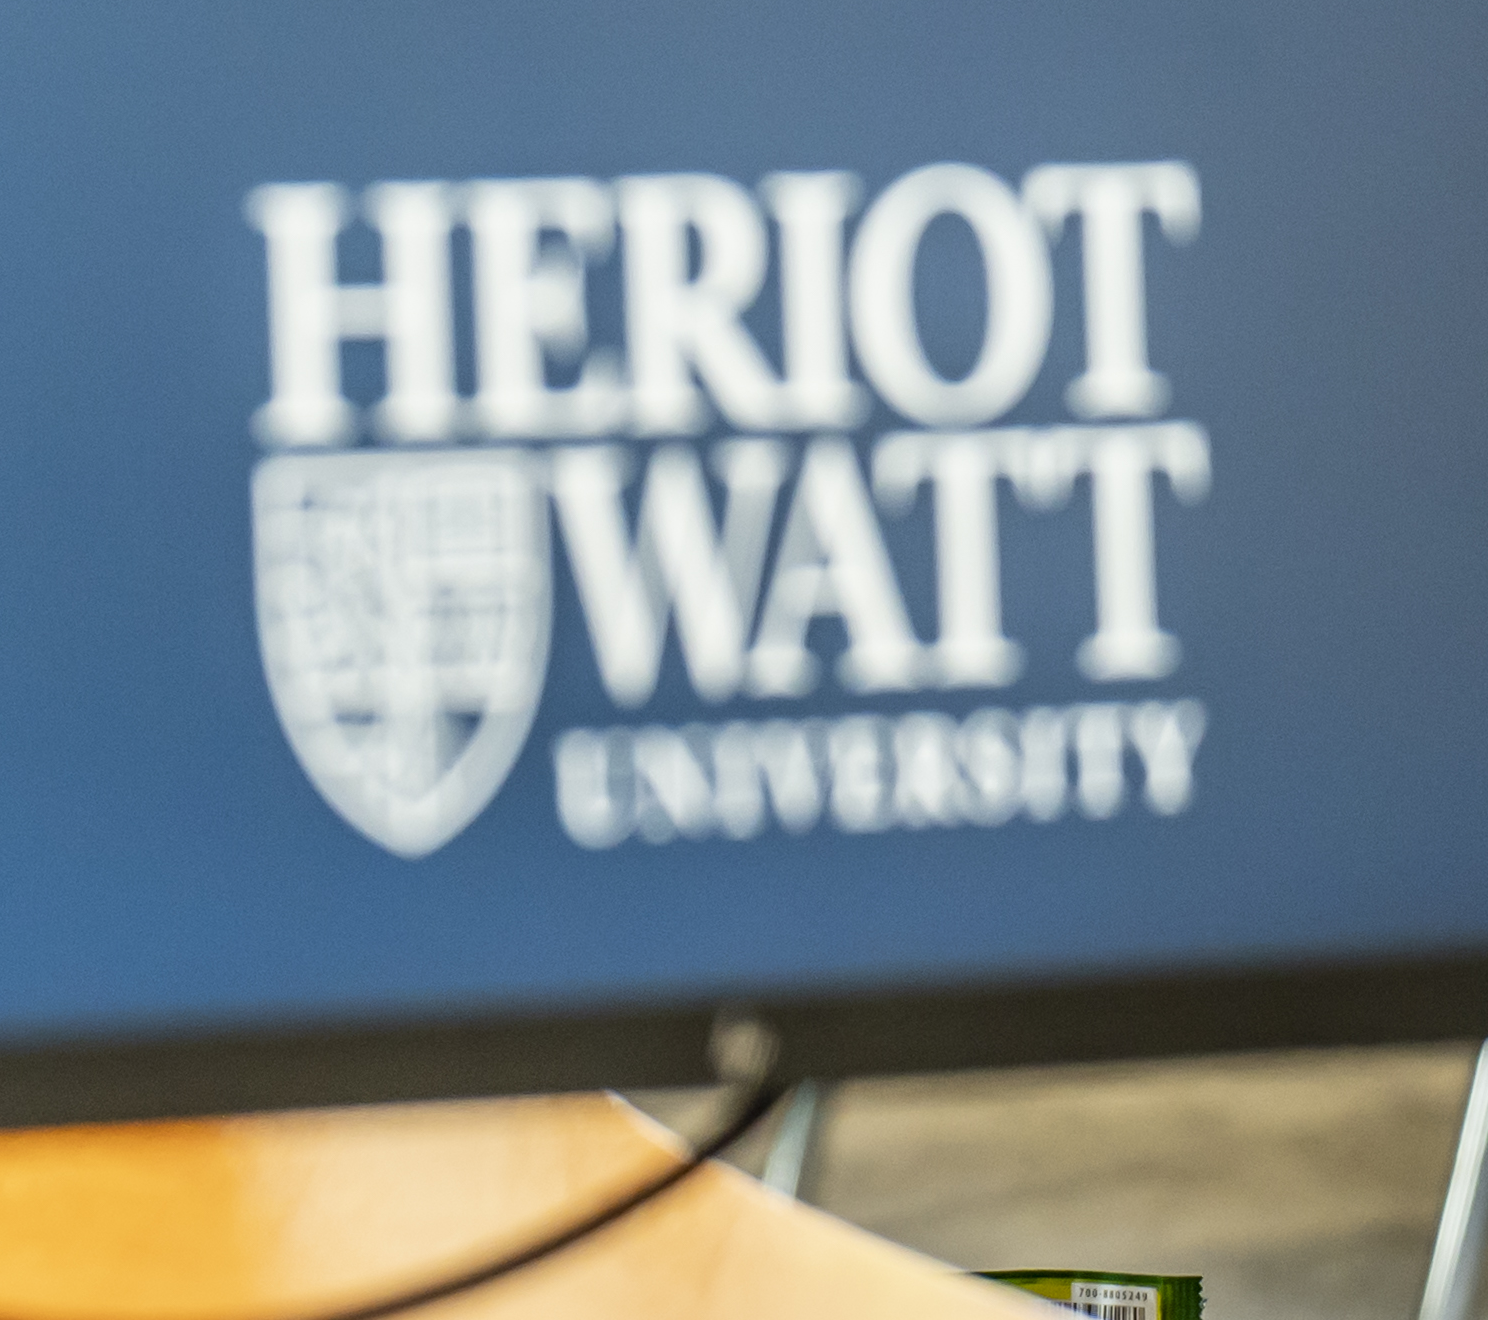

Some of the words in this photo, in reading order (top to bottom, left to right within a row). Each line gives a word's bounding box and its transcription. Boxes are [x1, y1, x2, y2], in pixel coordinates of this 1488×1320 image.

[248, 161, 1201, 444] HERIOT
[550, 421, 1210, 707] WATT
[554, 701, 1204, 847] UNIVERSITY
